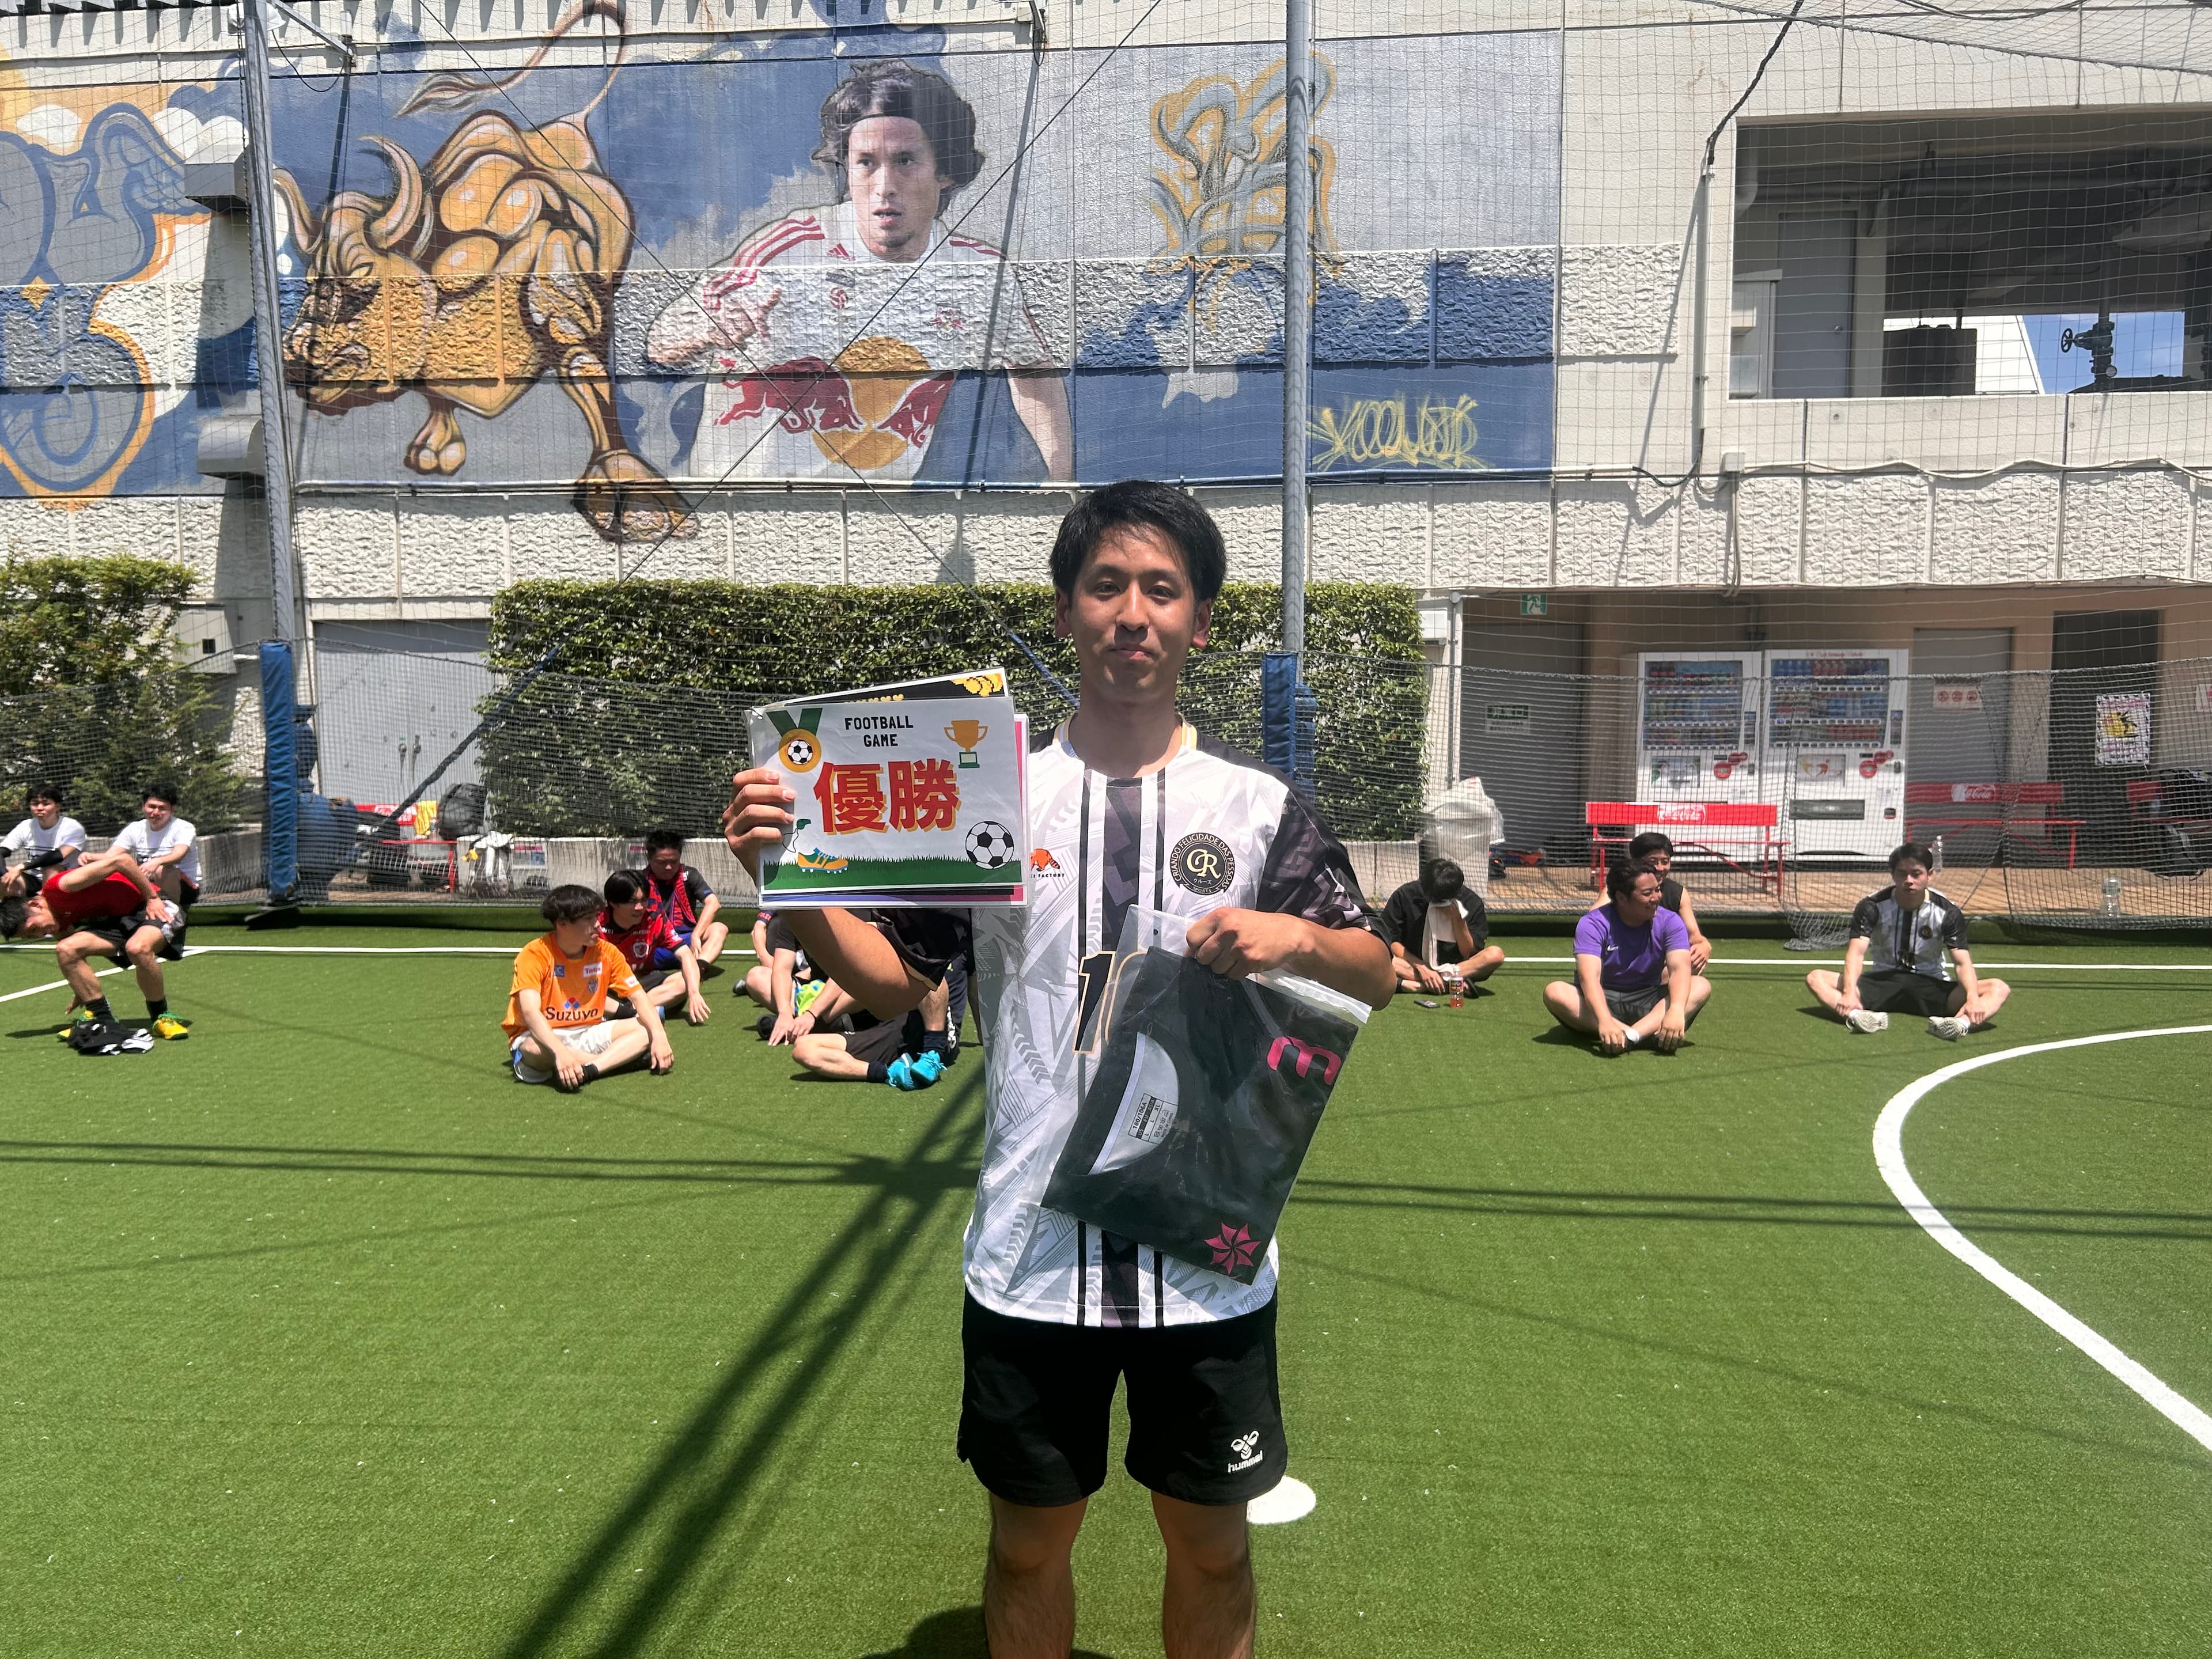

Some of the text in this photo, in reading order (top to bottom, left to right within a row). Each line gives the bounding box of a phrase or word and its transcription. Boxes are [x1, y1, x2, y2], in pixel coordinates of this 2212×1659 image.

[844, 715, 914, 730] FOOTBALL
[864, 734, 899, 748] GAME
[813, 759, 962, 836] 優勝
[1171, 834, 1234, 889] CRIANDO FELICIDADE DAS PESSOAS
[1132, 1102, 1147, 1129] 180/106A
[1228, 1450, 1263, 1472] hummel
